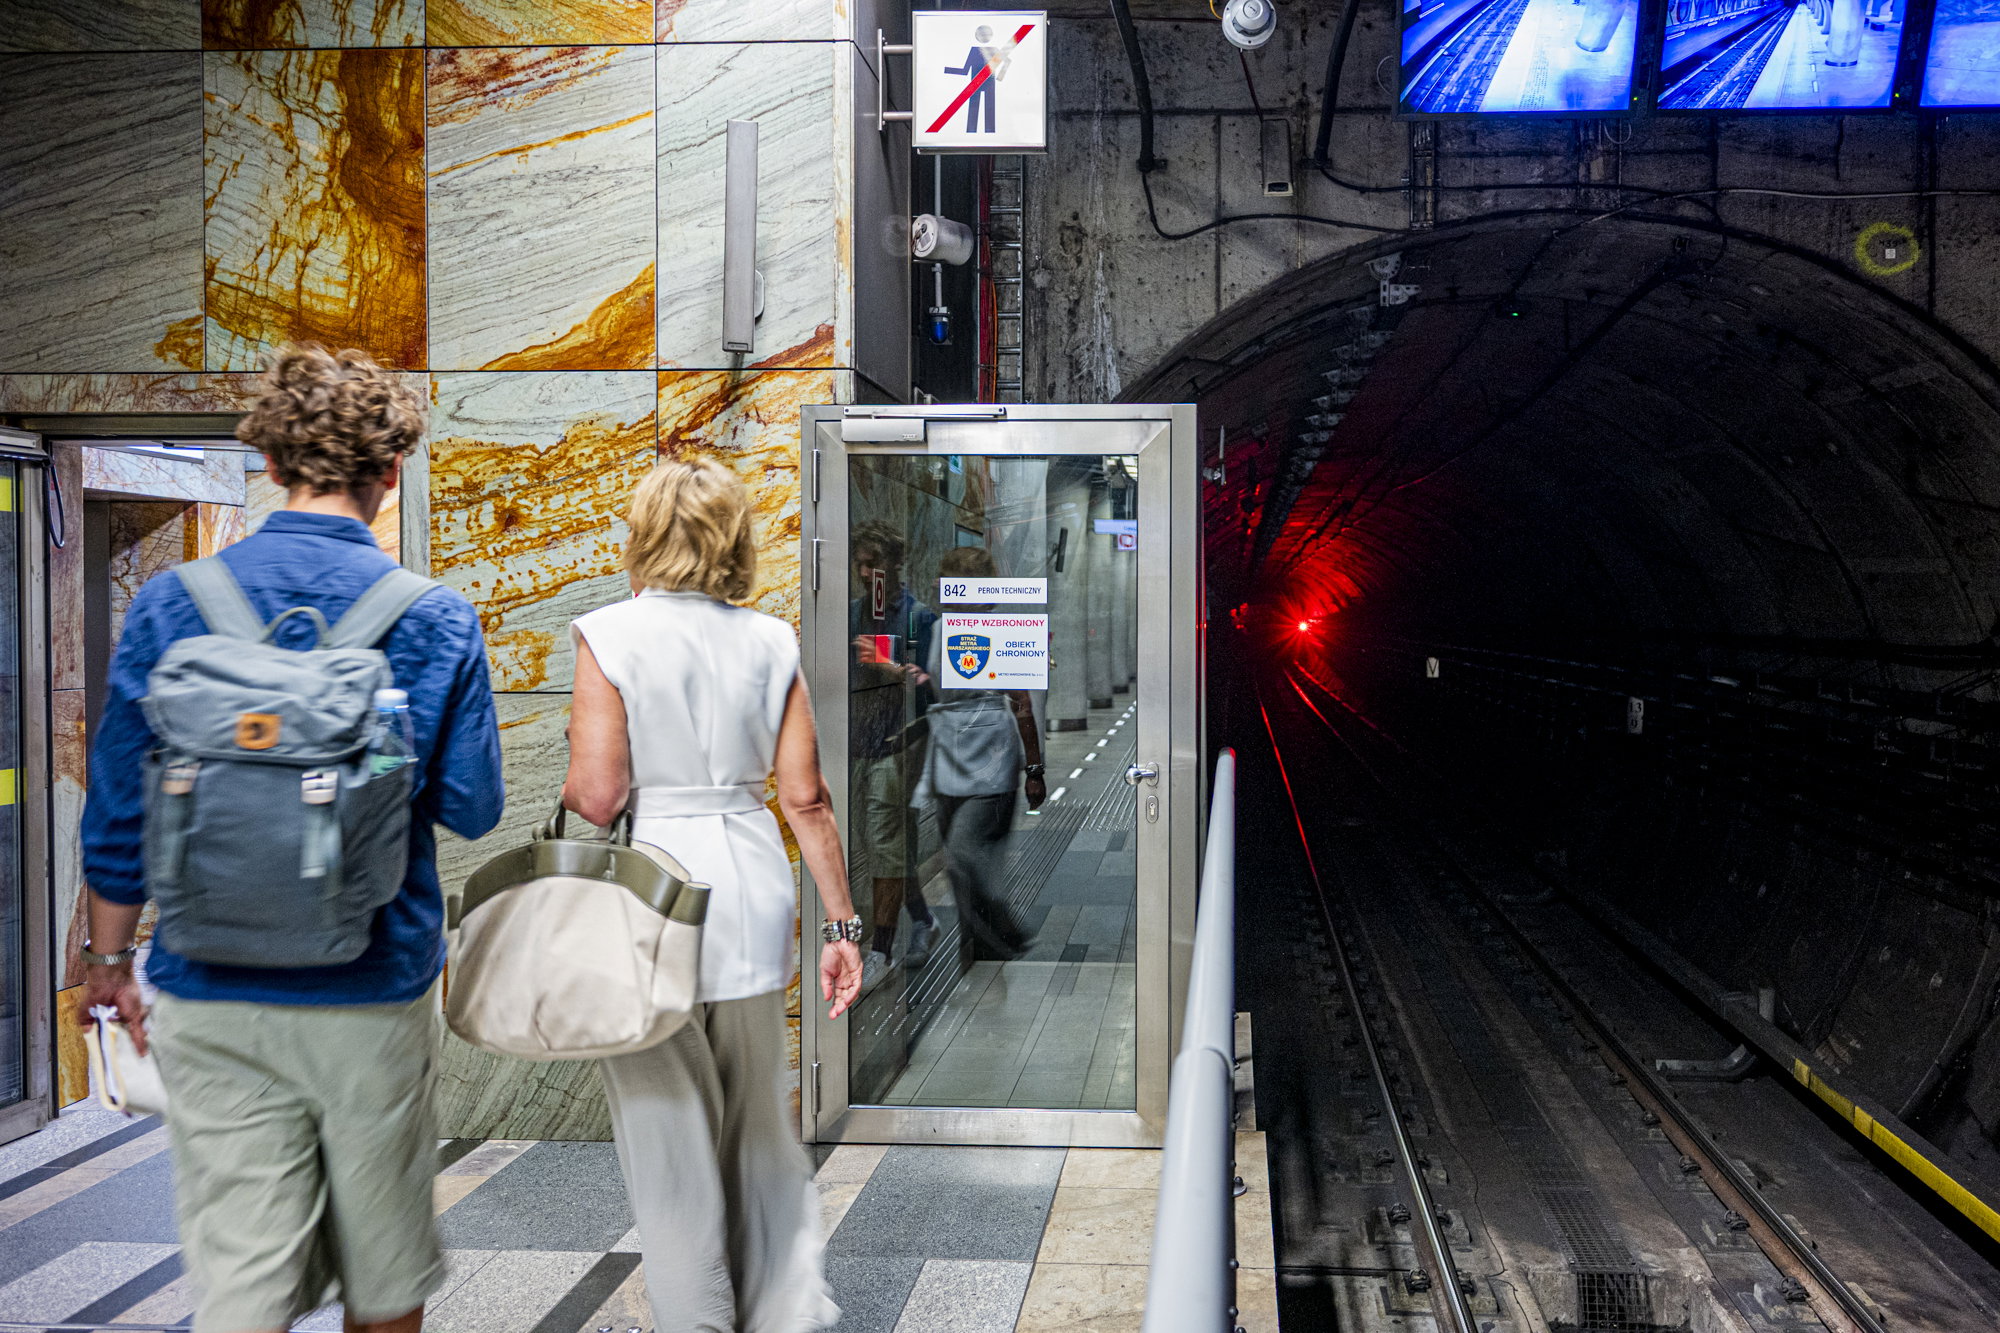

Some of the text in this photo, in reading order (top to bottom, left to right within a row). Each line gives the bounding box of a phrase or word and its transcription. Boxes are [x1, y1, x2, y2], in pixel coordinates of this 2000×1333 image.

[944, 584, 967, 597] 842
[1001, 587, 1042, 595] TECHNICZNY
[946, 619, 1045, 628] WSTĘP WZBRONIONY
[963, 657, 975, 667] M
[1629, 702, 1642, 713] 13
